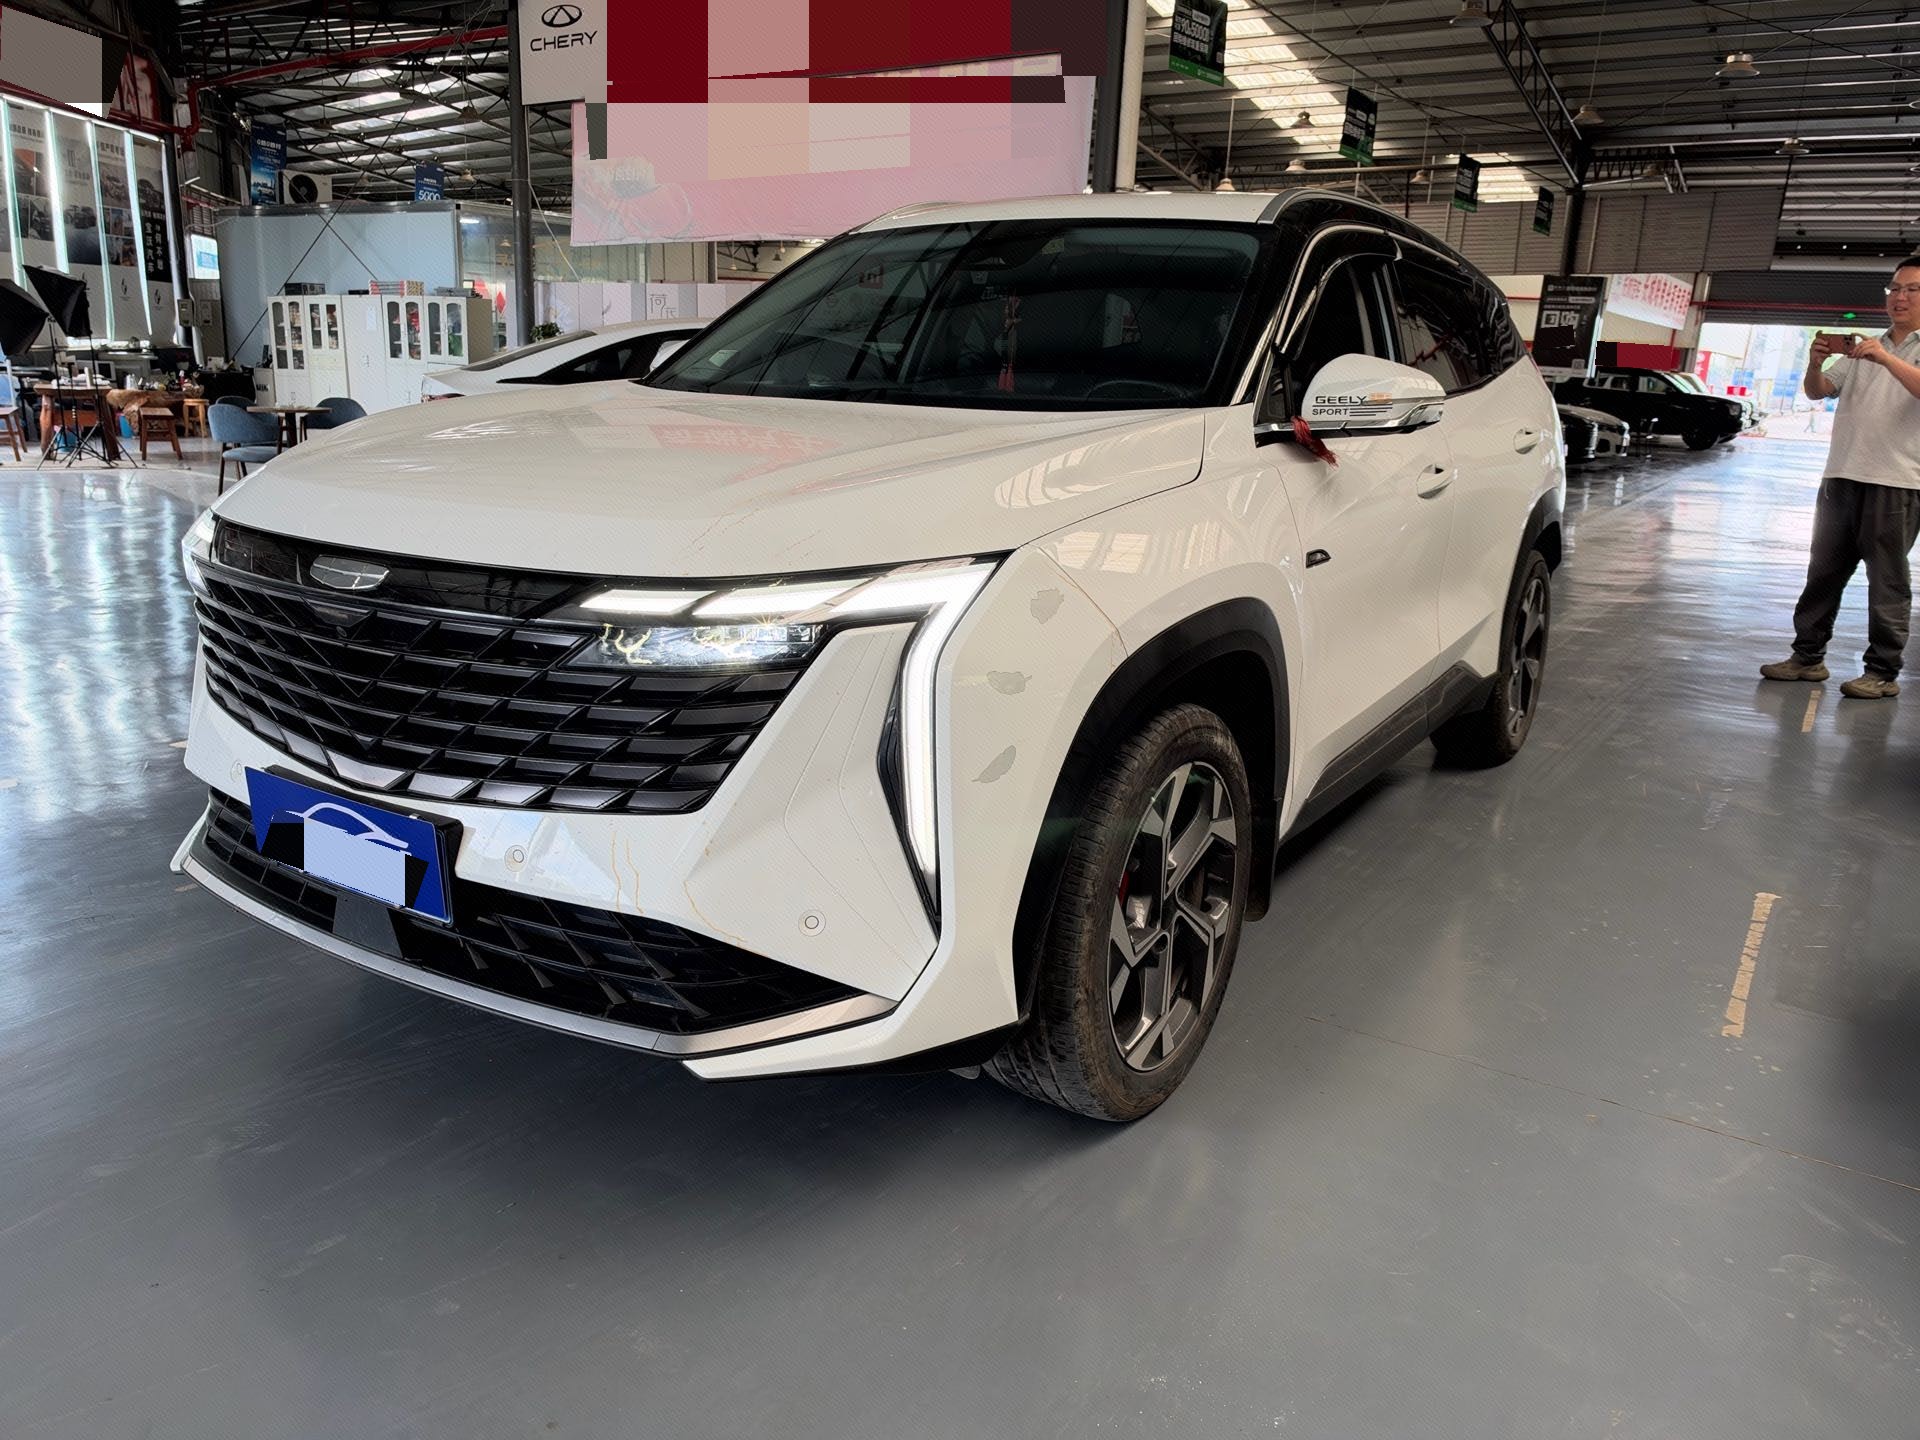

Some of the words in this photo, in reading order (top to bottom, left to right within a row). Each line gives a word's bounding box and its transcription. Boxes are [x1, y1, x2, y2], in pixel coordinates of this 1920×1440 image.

[530, 30, 598, 52] CHERY
[1315, 395, 1367, 406] GEELY
[1312, 408, 1349, 416] SPORT
